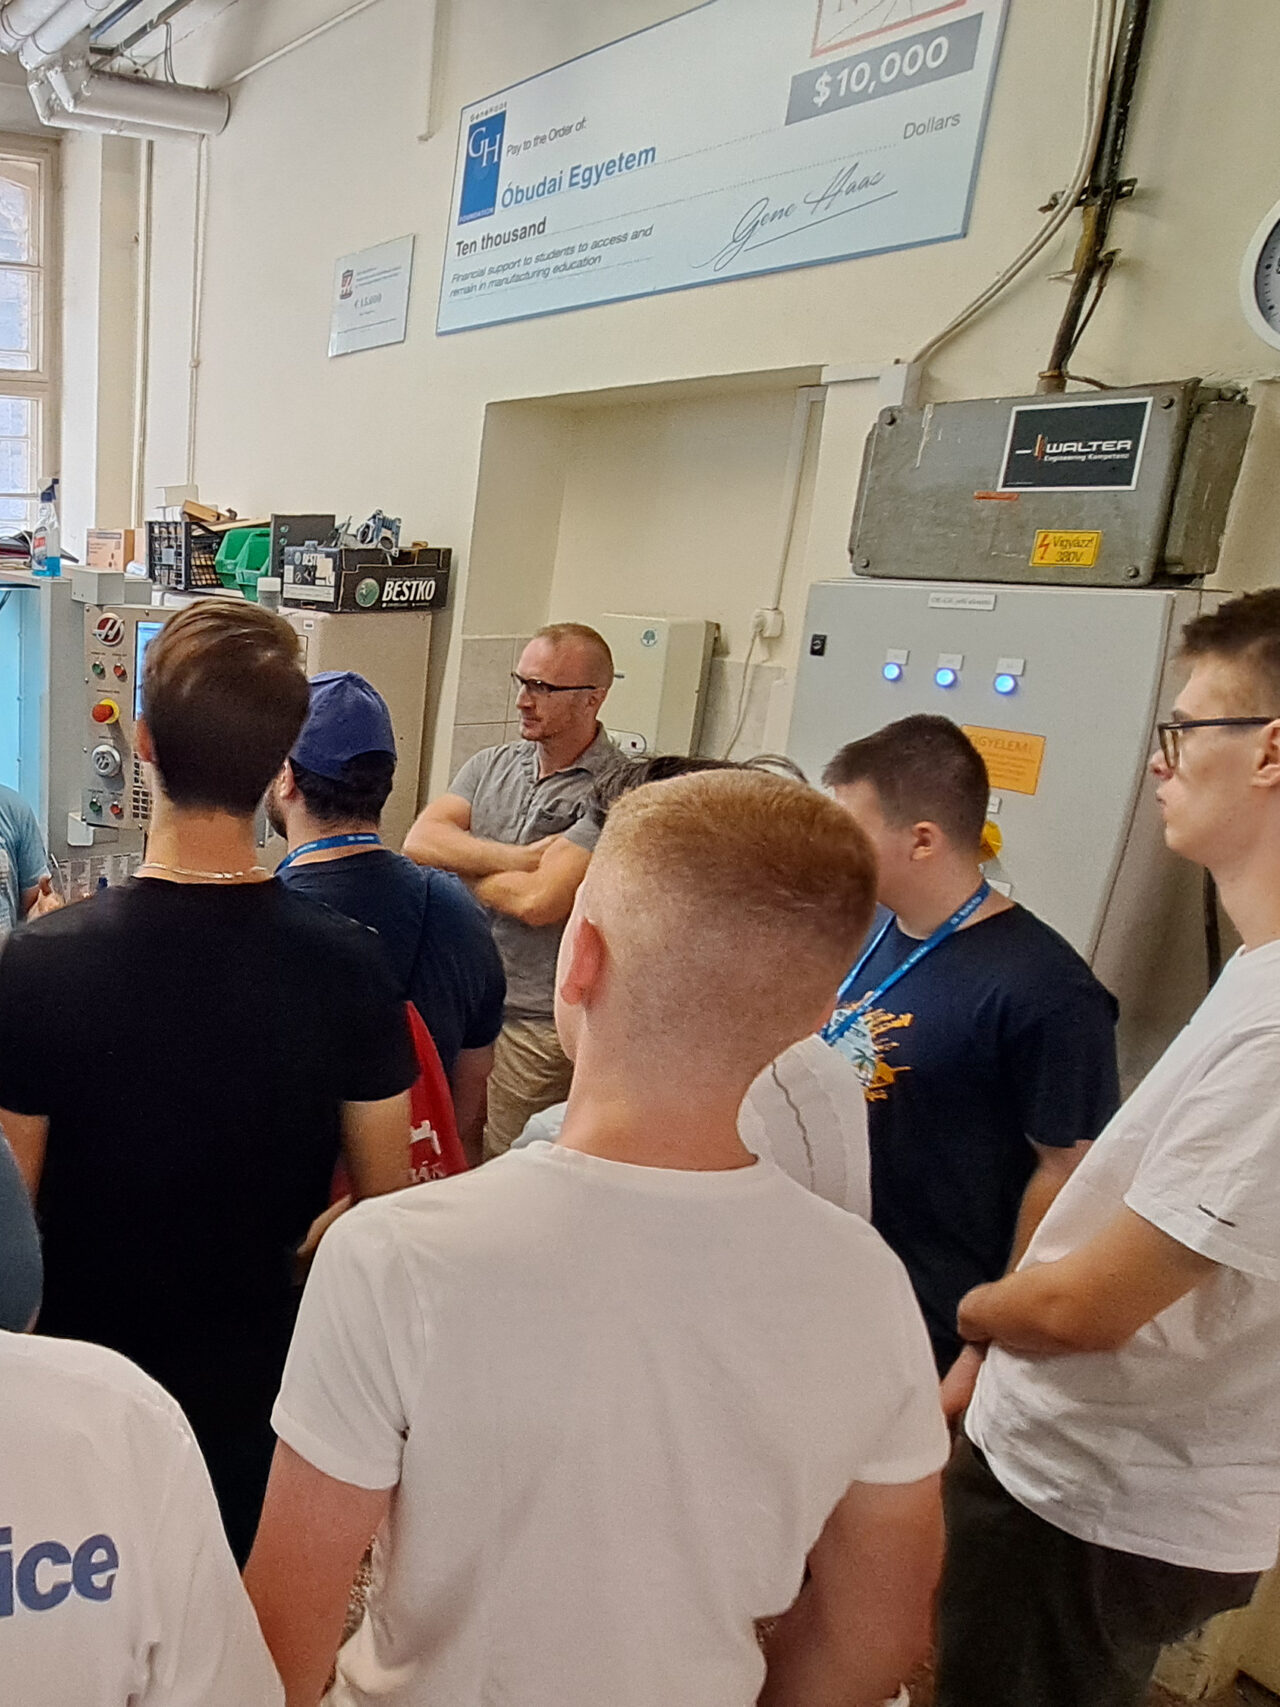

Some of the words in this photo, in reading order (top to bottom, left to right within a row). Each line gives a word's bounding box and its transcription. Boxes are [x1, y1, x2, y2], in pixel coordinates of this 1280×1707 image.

[506, 144, 522, 157] Pay
[523, 140, 532, 150] to
[533, 134, 547, 148] the
[549, 125, 573, 142] Order
[903, 114, 961, 140] Dollars
[501, 170, 564, 209] Óbudai
[568, 146, 657, 190] Egyetem
[451, 266, 487, 284] Financial
[487, 258, 522, 275] support
[523, 254, 533, 266] to
[534, 246, 576, 264] students
[578, 241, 589, 253] to
[591, 231, 629, 249] access
[630, 224, 654, 241] and
[456, 238, 477, 257] Ten
[481, 216, 548, 251] thousand
[449, 284, 477, 297] remain
[478, 280, 487, 291] in
[488, 266, 551, 289] manufacturing
[552, 254, 602, 274] education
[1046, 440, 1132, 454] WALTER
[381, 580, 436, 601] BESTKO
